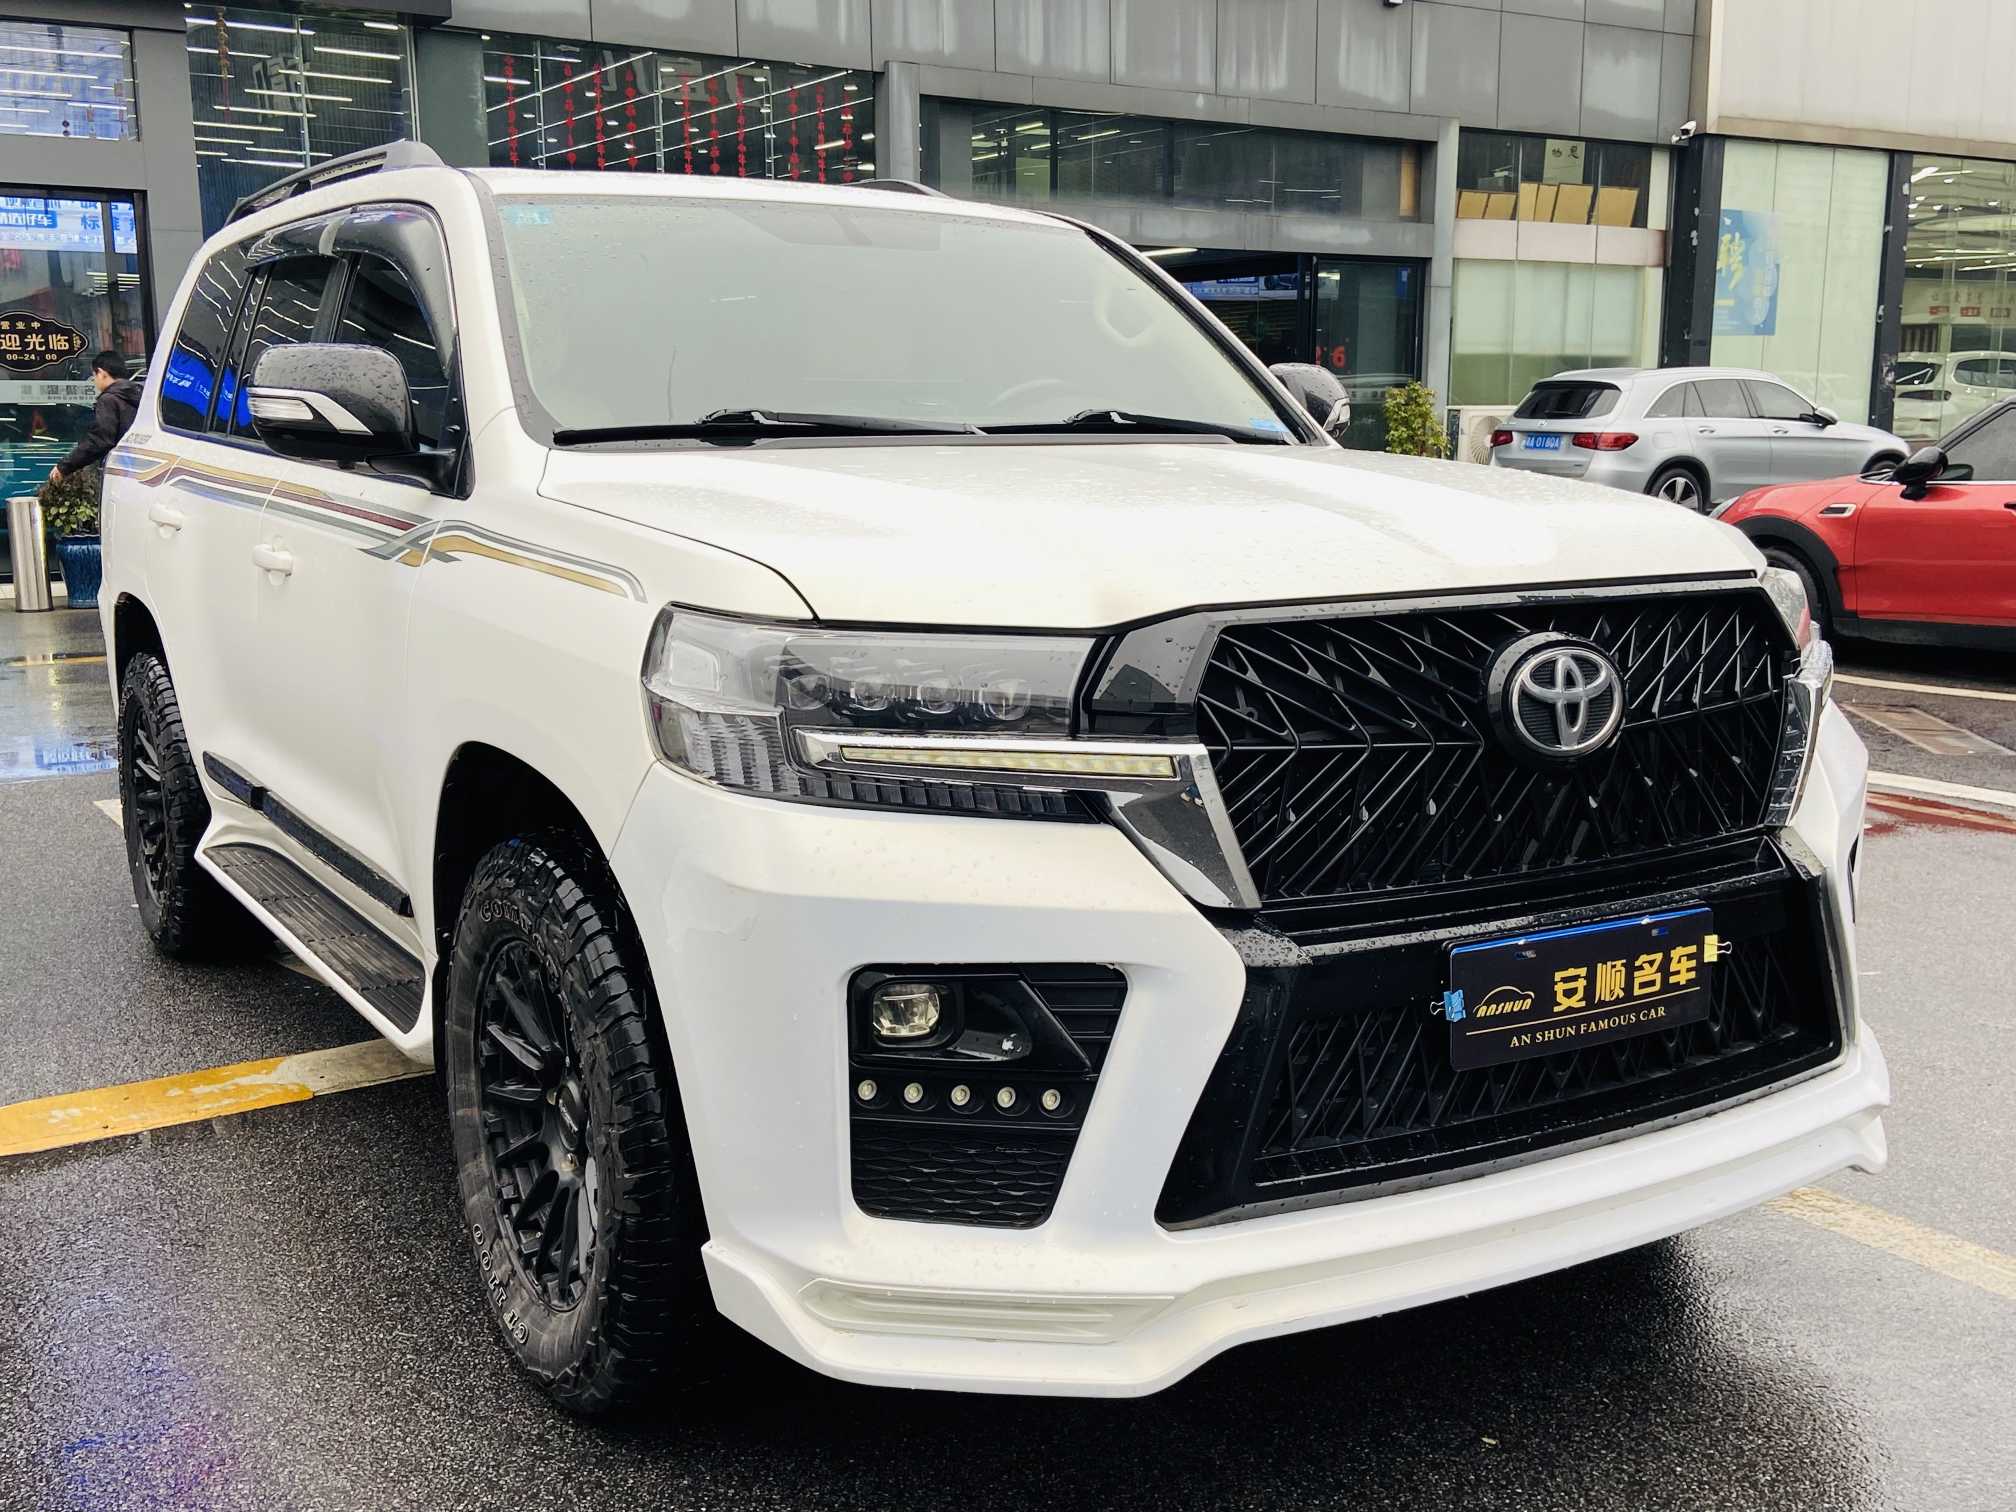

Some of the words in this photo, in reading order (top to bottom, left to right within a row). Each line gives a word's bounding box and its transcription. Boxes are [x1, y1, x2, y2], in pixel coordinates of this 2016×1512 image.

[0, 333, 70, 351] 迎光临
[1553, 944, 1697, 1012] 安顺名车
[1510, 1033, 1531, 1048] AN
[1536, 1025, 1576, 1043] SHUN
[1580, 1012, 1636, 1034] FAMOUS
[1640, 1006, 1666, 1021] CAR
